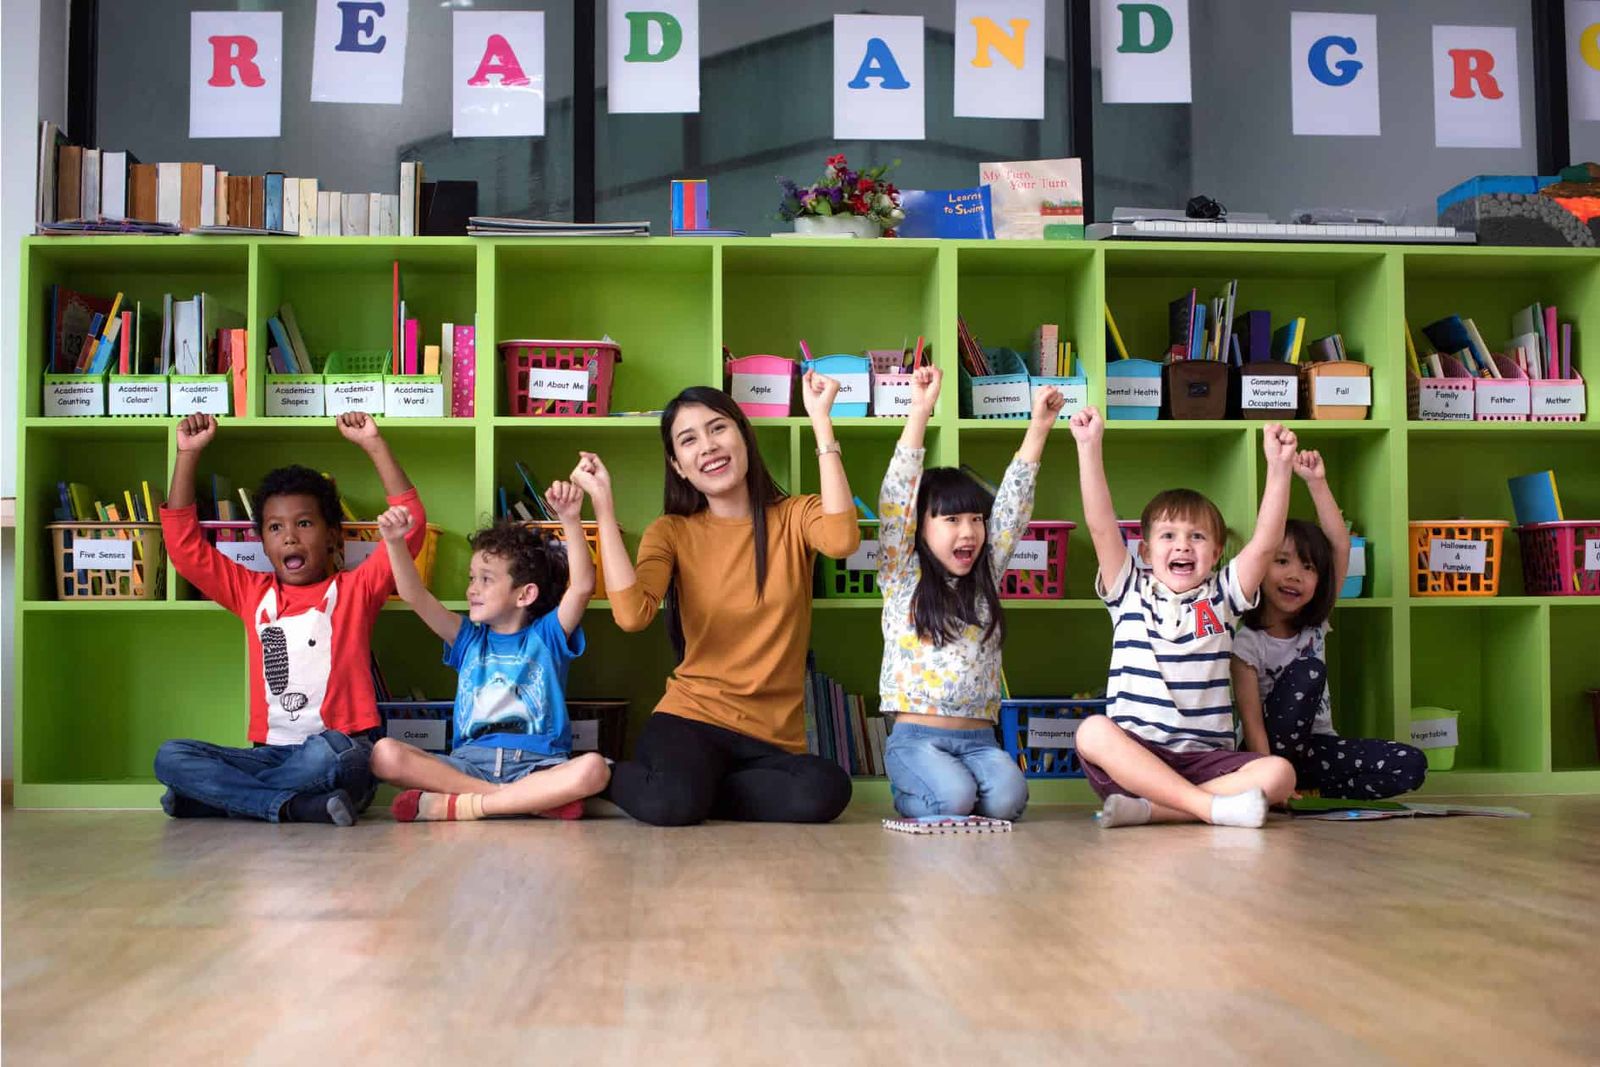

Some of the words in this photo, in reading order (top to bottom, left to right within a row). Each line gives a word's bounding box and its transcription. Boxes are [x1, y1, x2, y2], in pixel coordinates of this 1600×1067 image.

[1041, 178, 1068, 188] Turn
[944, 205, 954, 214] to
[955, 203, 984, 215] Swim
[547, 381, 569, 389] About
[572, 382, 584, 390] Me
[1250, 378, 1289, 388] Community
[54, 386, 94, 395] Academics
[118, 385, 158, 393] Academics
[179, 385, 219, 394] Academics
[275, 387, 315, 395] Academics
[334, 386, 374, 394] Academics
[394, 386, 434, 394] Academics
[750, 385, 771, 394] Apple
[1106, 388, 1131, 396] Dental
[1133, 389, 1159, 397] Health
[1252, 388, 1287, 397] Workers/
[1335, 387, 1350, 396] Fall
[1435, 390, 1459, 401] Family
[57, 397, 90, 406] Counting
[280, 397, 309, 406] Shapes
[894, 396, 912, 405] Bugs
[983, 396, 1021, 405] Christmas
[1247, 400, 1291, 409] Occupations
[1490, 396, 1516, 405] Father
[1545, 397, 1572, 405] Mother
[1422, 410, 1470, 420] Grandparents
[1440, 541, 1477, 550] Halloween
[79, 550, 96, 559] Five
[99, 551, 126, 560] Senses
[236, 553, 255, 562] Food
[1442, 563, 1472, 572] Pumpkin
[1191, 599, 1226, 638] A
[404, 730, 429, 739] Ocean
[1029, 729, 1075, 739] Transportat
[1410, 730, 1447, 741] Vegetable
